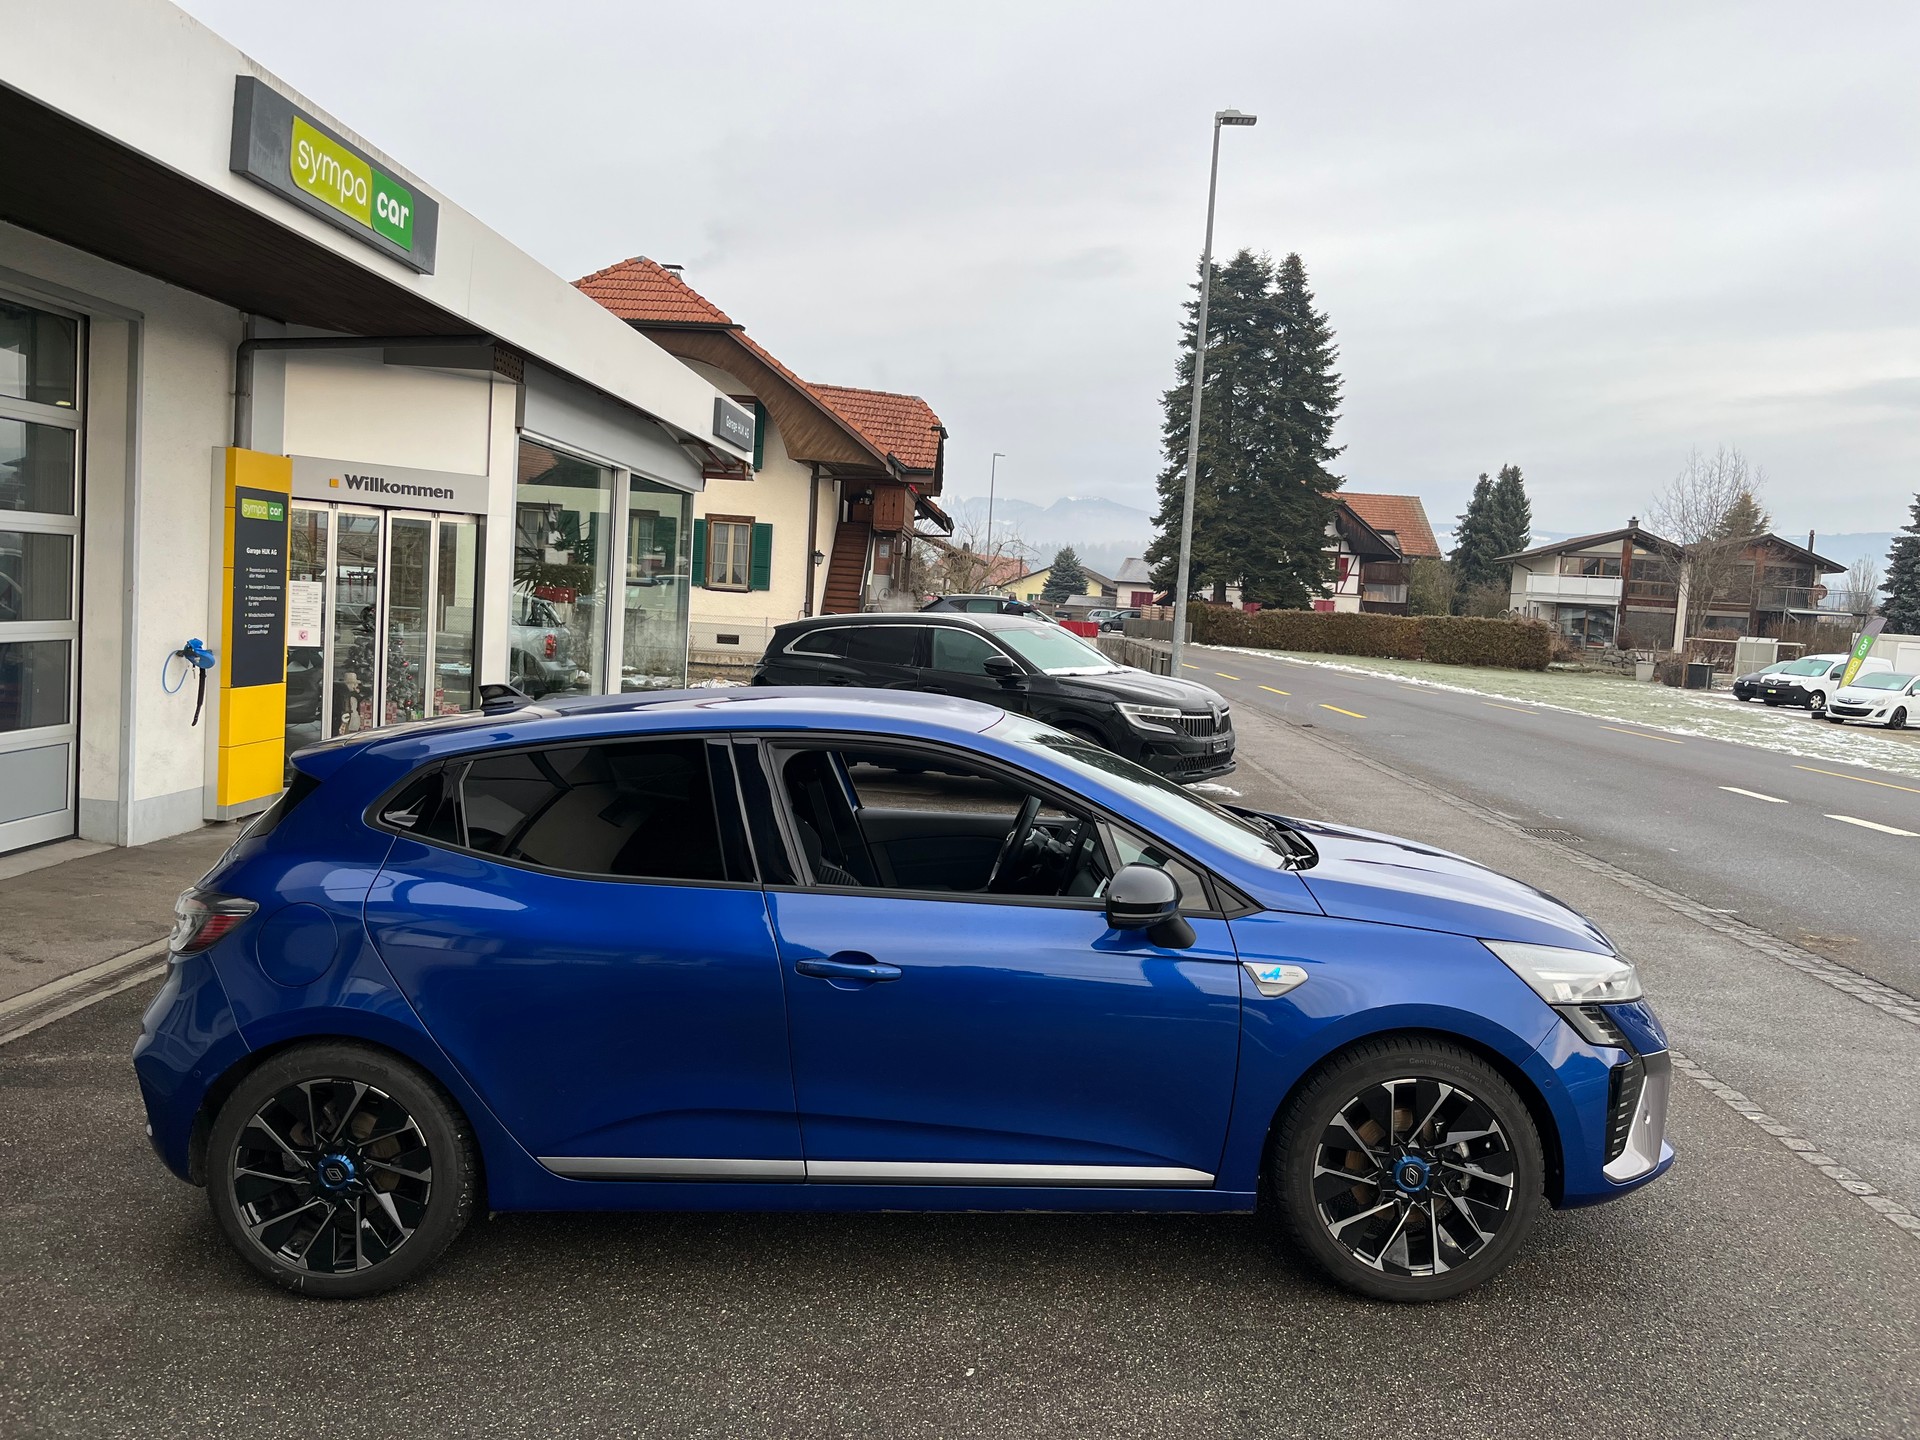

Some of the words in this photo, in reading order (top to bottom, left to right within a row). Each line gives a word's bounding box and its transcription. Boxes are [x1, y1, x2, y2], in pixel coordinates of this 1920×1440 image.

[298, 139, 367, 206] sympa
[376, 191, 409, 229] car
[344, 474, 454, 499] Willkommen
[243, 503, 267, 517] sympa
[269, 506, 282, 516] car
[246, 547, 261, 555] Garage
[1858, 638, 1868, 656] car
